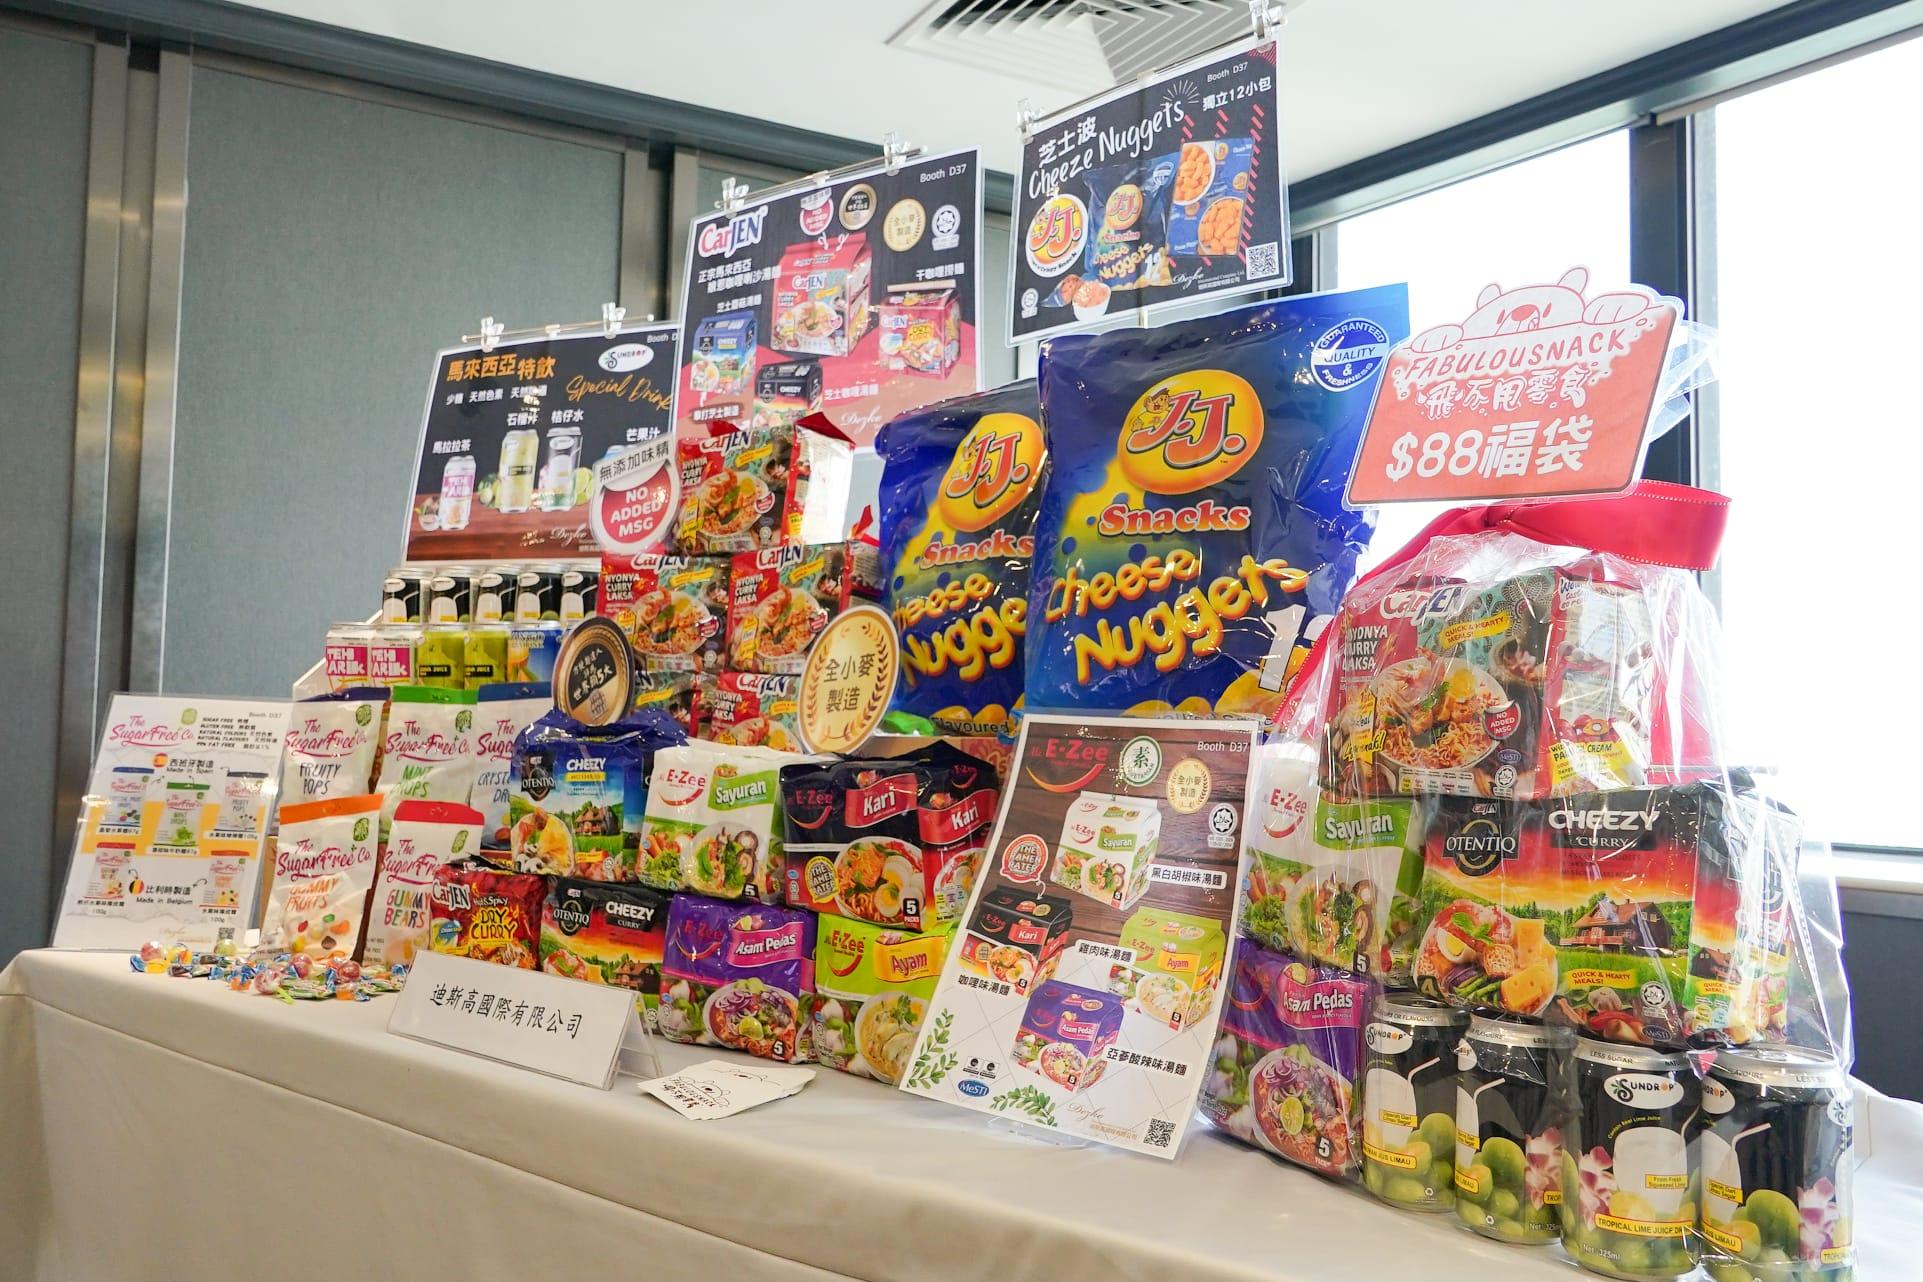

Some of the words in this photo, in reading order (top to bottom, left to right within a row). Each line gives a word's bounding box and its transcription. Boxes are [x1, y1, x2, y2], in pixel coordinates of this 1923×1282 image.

[1207, 68, 1229, 83] Booth
[1233, 62, 1248, 74] D37
[1202, 77, 1271, 111] 獨立12小包
[1029, 147, 1093, 200] Cheeze
[1099, 100, 1185, 158] Nuggets
[1039, 116, 1097, 167] 芝士波
[920, 169, 945, 182] Booth
[949, 163, 967, 177] D37
[698, 206, 766, 258] CarJEN
[647, 333, 668, 343] Booth
[1320, 322, 1385, 348] GUARANTEED
[1406, 328, 1626, 381] FABULOUSNACK
[447, 354, 556, 382] 馬來西亞特飲
[1322, 362, 1374, 386] FRESHNESS
[1343, 363, 1352, 376] &
[566, 374, 633, 402] Special
[700, 431, 754, 456] CarJEN
[1386, 415, 1593, 482] $88福袋
[599, 440, 670, 481] 無添加味精
[625, 486, 648, 503] NO
[610, 501, 662, 525] ADDED
[1099, 500, 1250, 537] Snacks
[618, 517, 654, 538] MSG
[756, 545, 803, 571] CarJEN
[920, 528, 1035, 570] Snacks
[631, 552, 689, 574] CarJEN
[605, 573, 640, 583] NYONYA
[606, 582, 633, 592] CURRY
[736, 573, 763, 587] NYONYA
[1045, 549, 1200, 623] Cheese
[606, 591, 633, 601] LAKSA
[735, 583, 758, 597] CURRY
[734, 594, 758, 606] LAKSA
[1380, 586, 1472, 626] CarJEN
[1074, 554, 1310, 686] Nuggets
[1444, 624, 1467, 637] QUICK
[1476, 616, 1504, 630] HEARTY
[823, 653, 876, 684] 全小麥
[737, 674, 790, 697] CarJEN
[826, 687, 861, 713] 製造
[130, 715, 145, 727] The
[1490, 718, 1515, 729] ADDED
[1496, 711, 1508, 719] NO
[305, 719, 321, 735] The
[404, 720, 421, 736] The
[497, 719, 514, 735] The
[1495, 726, 1512, 735] MSG
[1197, 742, 1225, 752] Booth
[1229, 742, 1249, 752] D37
[1586, 743, 1612, 753] CREAM
[169, 758, 214, 769] 西班牙製造
[566, 758, 606, 771] CHEEZY
[1134, 746, 1150, 769] 素
[197, 767, 214, 775] Spain
[300, 763, 342, 779] FRUITY
[304, 779, 329, 795] POPS
[716, 781, 767, 808] Sayuran
[863, 783, 896, 817] Kari
[952, 801, 979, 831] Kari
[1548, 810, 1660, 831] CHEEZY
[1326, 814, 1394, 846] Sayuran
[297, 839, 313, 853] The
[399, 839, 415, 855] The
[1019, 845, 1038, 855] THE
[1103, 838, 1132, 849] Sayuran
[1446, 836, 1516, 854] OTENTIQ
[1577, 837, 1631, 847] CURRY
[277, 847, 355, 878] SugarFree
[1011, 853, 1041, 864] RAMEN
[146, 885, 191, 896] 比利時製造
[386, 889, 432, 907] GUMMY
[432, 881, 471, 910] CarJEN
[744, 884, 756, 896] 5
[167, 898, 193, 906] Belgium
[605, 901, 655, 920] CHEEZY
[906, 900, 917, 915] 5
[384, 911, 425, 928] BEARS
[480, 907, 507, 924] DRY
[554, 908, 590, 926] OTENTIQ
[617, 919, 641, 929] CURRY
[471, 922, 517, 940] CURRY
[1018, 931, 1038, 940] Kari
[736, 941, 763, 956] Asam
[765, 933, 797, 952] Pedas
[1078, 943, 1132, 963] 雞肉味湯麵
[891, 952, 929, 977] Ayam
[1166, 958, 1189, 969] Ayam
[1356, 954, 1367, 973] 5
[1284, 992, 1311, 1013] Asam
[1313, 988, 1353, 1014] Pedas
[431, 982, 583, 1041] 迪斯高國際有限公司
[1367, 1026, 1403, 1046] SUNDROP
[773, 1041, 784, 1055] 5
[1590, 1050, 1606, 1059] LESS
[1607, 1053, 1633, 1064] SUGAR
[960, 1082, 988, 1097] MeSTI
[1617, 1078, 1674, 1102] SUNDROP
[1318, 1138, 1331, 1159] 5
[1390, 1155, 1411, 1166] LIMAU
[1598, 1217, 1632, 1232] TROPICAL
[1634, 1225, 1652, 1233] LIME
[1715, 1234, 1736, 1247] LIMAU
